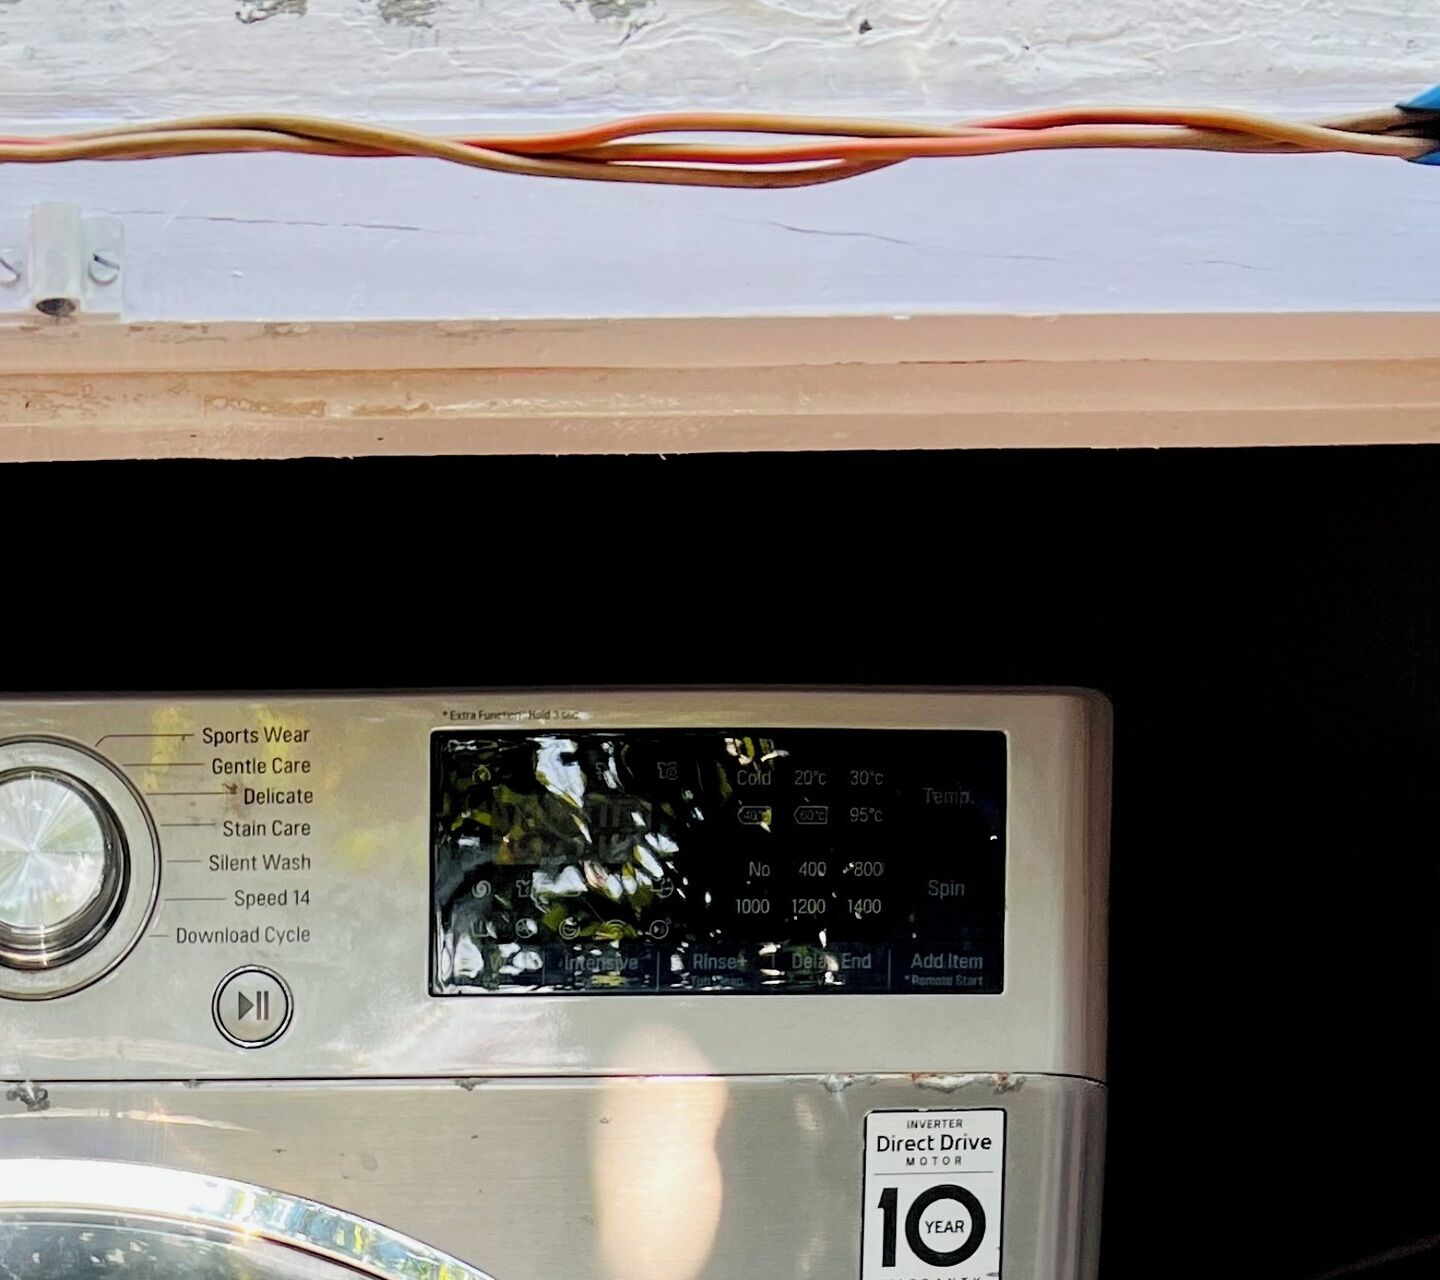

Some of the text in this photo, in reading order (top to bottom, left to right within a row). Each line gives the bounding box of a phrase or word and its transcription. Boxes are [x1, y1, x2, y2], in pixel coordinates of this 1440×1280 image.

[449, 710, 476, 720] Extra
[202, 726, 311, 747] Sports Wear
[211, 758, 311, 775] Gentle Care
[736, 769, 772, 786] Cold
[243, 787, 314, 805] Delicate
[222, 820, 311, 837] Stain Care
[209, 853, 311, 871] Silent Wash
[748, 861, 882, 877] No 400 800
[927, 879, 966, 899] Spin
[234, 890, 311, 909] Speed 14
[735, 898, 882, 914] 1000 1200 1400
[175, 925, 311, 946] Download Cycle
[841, 952, 872, 969] End
[910, 952, 984, 969] Add Item
[906, 1118, 964, 1130] INVERTER
[876, 1132, 993, 1152] Direct Drive
[905, 1155, 963, 1167] MOTOR
[877, 1183, 987, 1268] 10
[925, 1220, 965, 1235] YEAR
